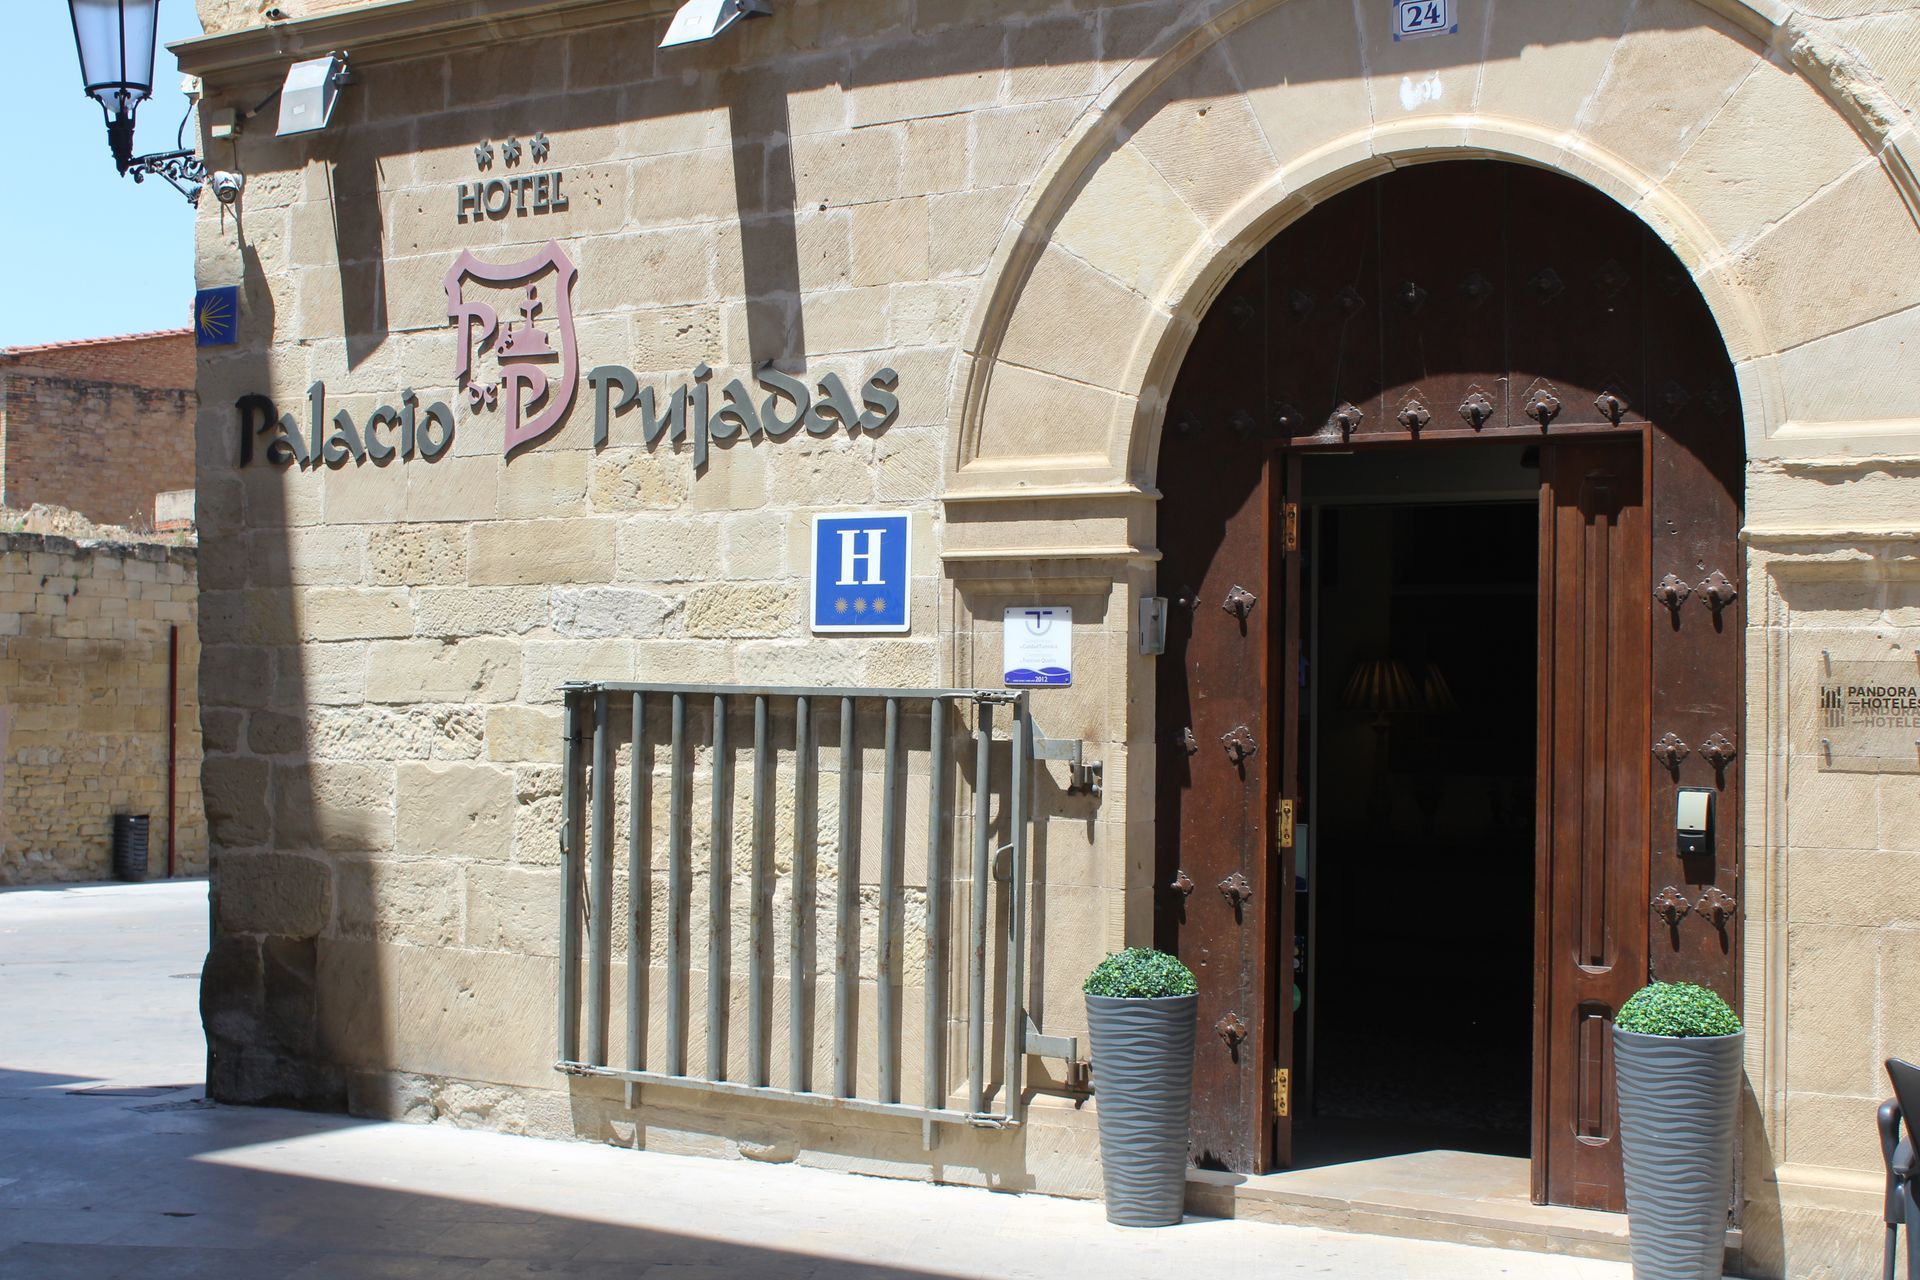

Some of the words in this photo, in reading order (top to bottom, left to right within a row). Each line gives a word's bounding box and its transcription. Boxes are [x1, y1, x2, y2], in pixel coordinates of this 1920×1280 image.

[1407, 2, 1440, 27] 24
[457, 171, 568, 223] HOTEL
[236, 380, 455, 470] Palacio
[466, 381, 498, 405] de
[587, 359, 900, 472] Pujadas
[835, 529, 887, 586] H
[1848, 686, 1917, 697] PANDORA
